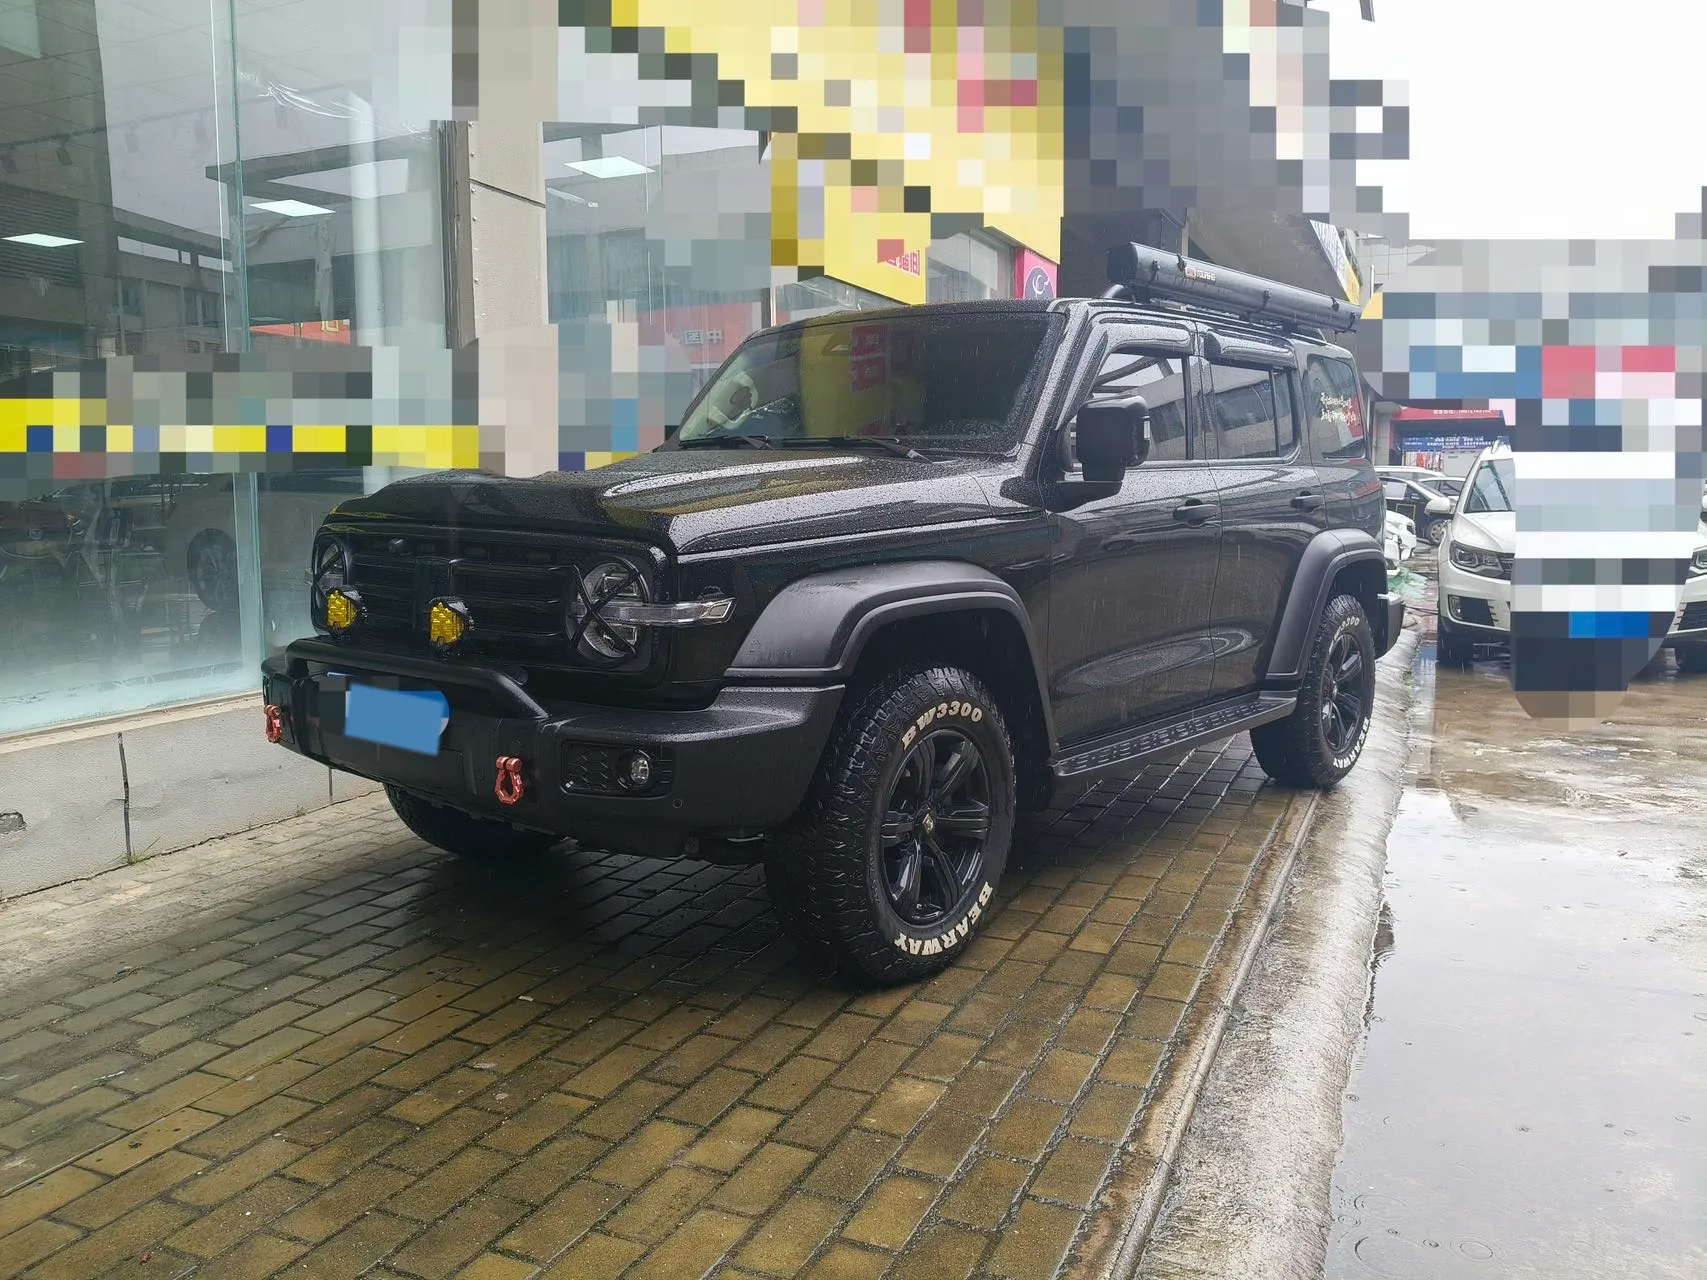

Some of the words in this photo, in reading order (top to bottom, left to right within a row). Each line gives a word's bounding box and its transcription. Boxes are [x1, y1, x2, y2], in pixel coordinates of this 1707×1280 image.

[1329, 616, 1360, 655] 3300
[902, 701, 982, 750] BW3300
[1333, 716, 1370, 769] BEARWAY
[894, 881, 993, 955] BEARWAY
